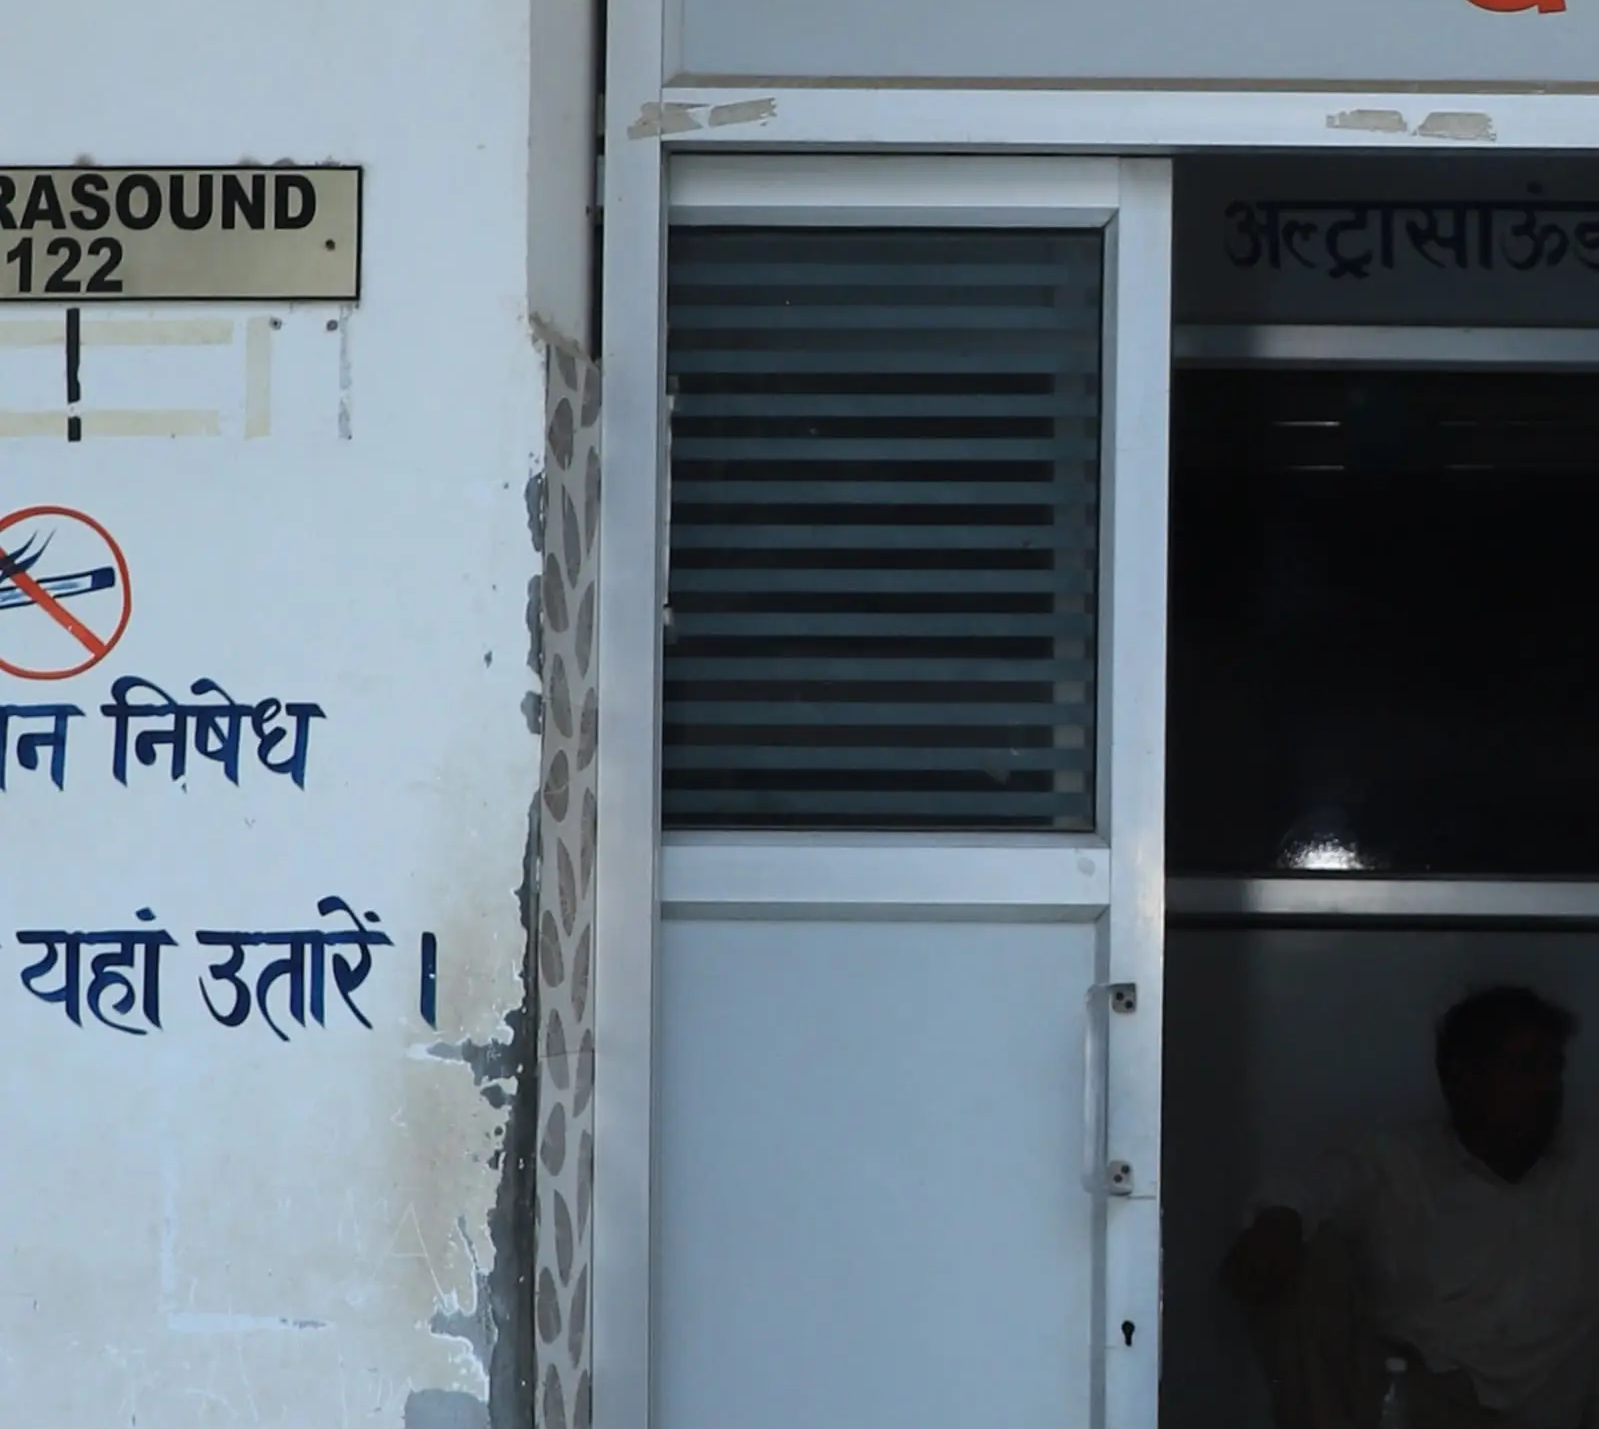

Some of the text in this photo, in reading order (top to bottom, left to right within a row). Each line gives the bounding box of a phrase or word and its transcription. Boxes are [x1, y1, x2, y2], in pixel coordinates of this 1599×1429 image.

[6, 237, 123, 293] 122
[101, 675, 327, 792] निषेध
[16, 907, 179, 1035] यहां
[195, 896, 395, 1041] उतारें
